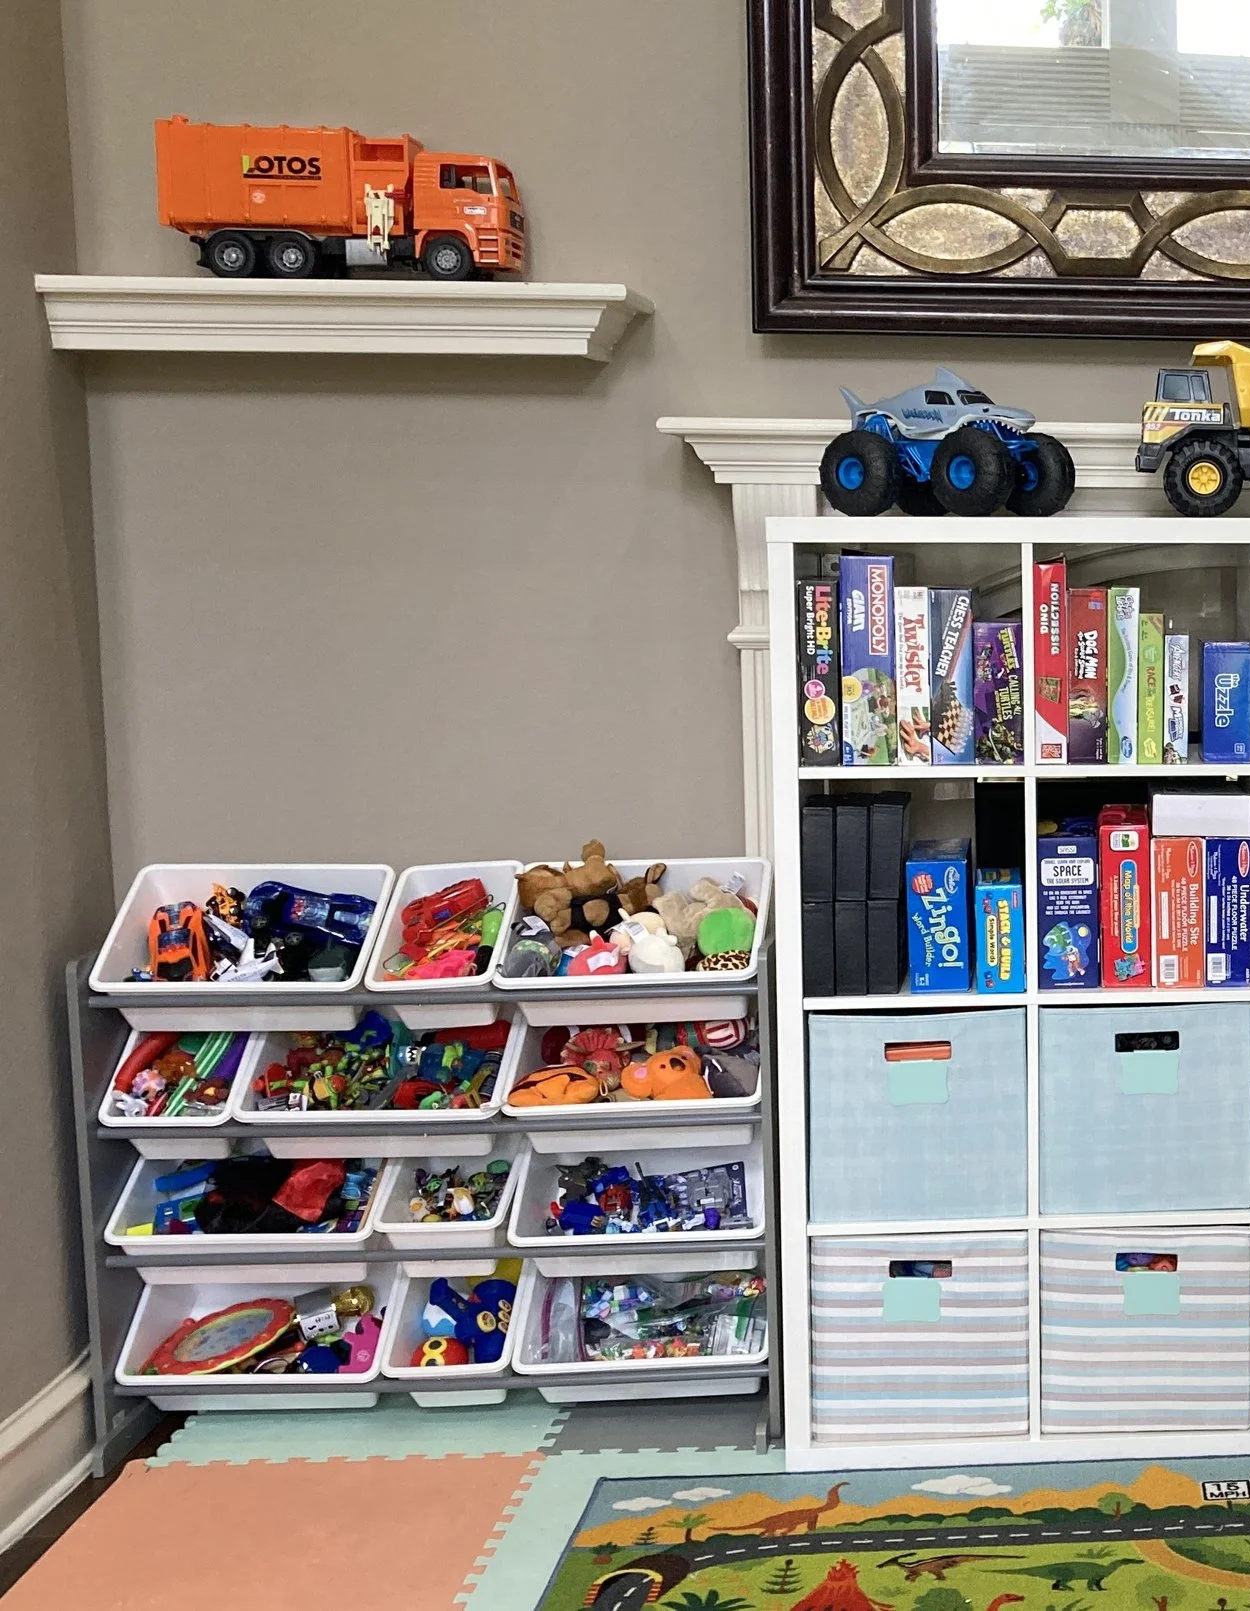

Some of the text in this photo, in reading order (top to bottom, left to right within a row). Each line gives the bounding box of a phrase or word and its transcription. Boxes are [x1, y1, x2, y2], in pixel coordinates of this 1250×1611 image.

[242, 155, 321, 175] LOTOS
[1169, 408, 1221, 421] Tonka
[804, 586, 814, 655] Super Bright HD
[852, 590, 865, 632] GIANT
[871, 568, 884, 653] MONOPOLY
[949, 596, 969, 629] CHESS
[1040, 604, 1049, 634] DINO
[1051, 583, 1060, 655] DISSECTION
[904, 614, 925, 692] Twister
[935, 631, 959, 677] TEACHER
[1084, 631, 1098, 679] DOG MAN
[1008, 675, 1020, 705] CALLING
[1145, 666, 1156, 688] RACE
[999, 687, 1012, 720] TURTLES
[1013, 705, 1022, 715] ALL
[1215, 674, 1233, 727] Uzzle
[1053, 865, 1082, 877] SPACE
[1123, 870, 1132, 890] Map
[1124, 892, 1132, 901] of
[1188, 884, 1199, 924] Building
[921, 888, 964, 967] Zingo!
[987, 918, 995, 940] Simple
[999, 900, 1010, 934] STACK
[1239, 885, 1250, 942] Underwater
[912, 913, 935, 967] Word Builder
[1125, 919, 1133, 943] World
[1190, 927, 1199, 945] Site
[1000, 948, 1011, 980] BUILD
[1212, 1482, 1240, 1490] 15
